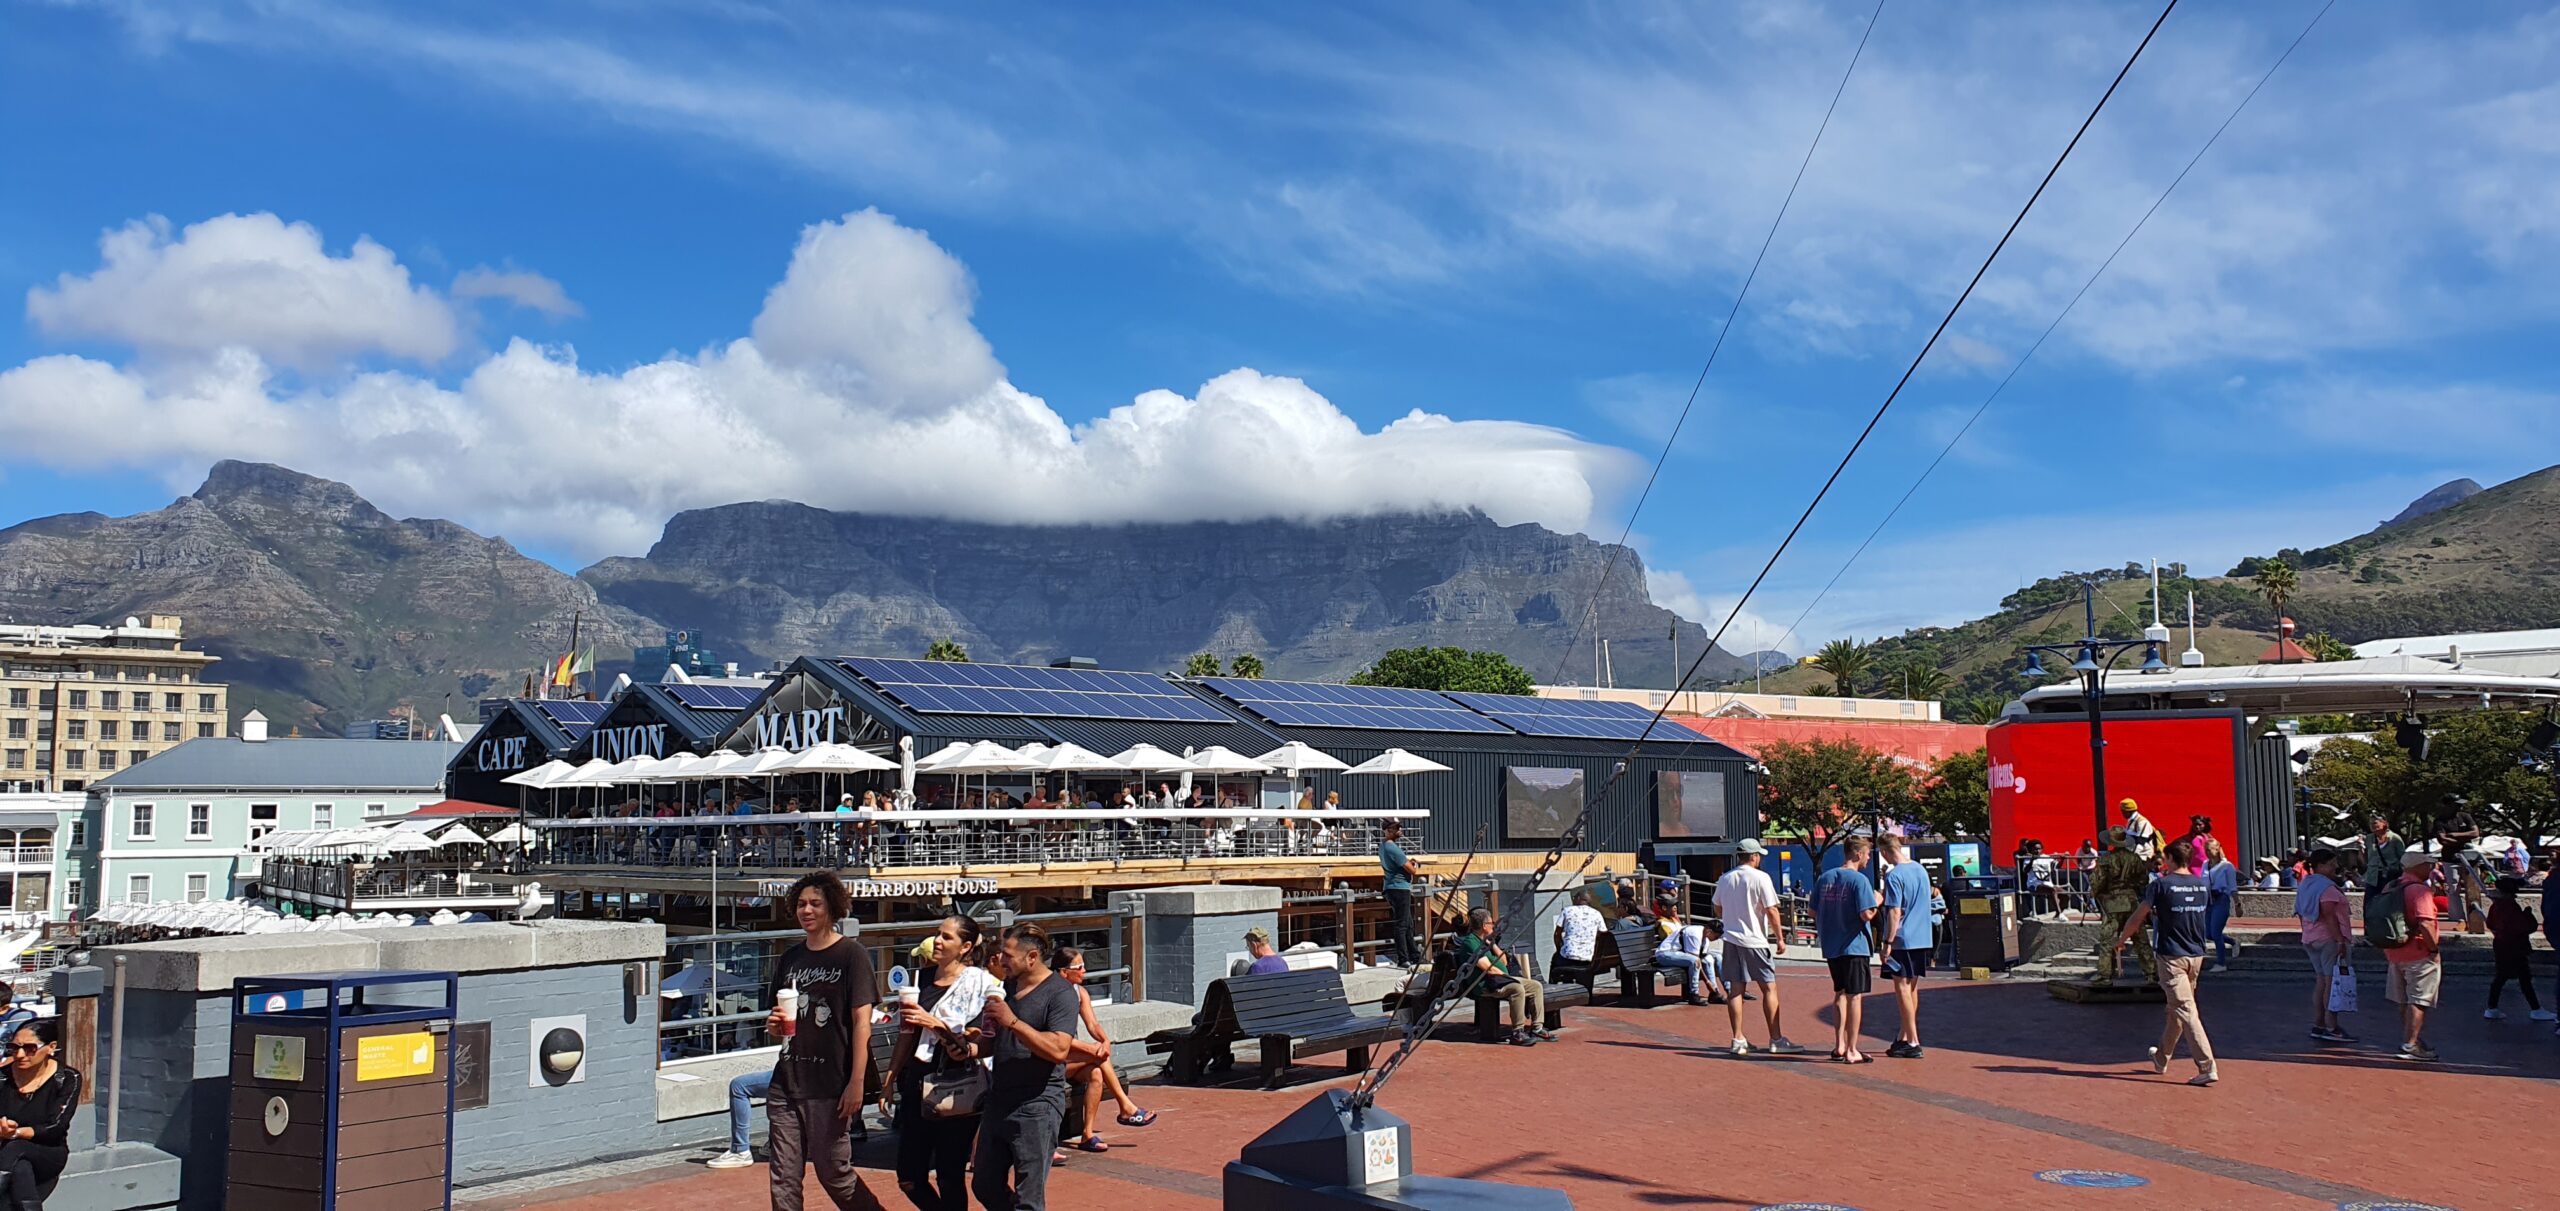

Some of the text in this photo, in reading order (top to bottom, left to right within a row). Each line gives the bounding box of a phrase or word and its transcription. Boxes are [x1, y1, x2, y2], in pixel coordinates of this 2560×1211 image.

[478, 706, 844, 772] CAPE UNION MART
[851, 879, 998, 897] HARBOUR HOUSE
